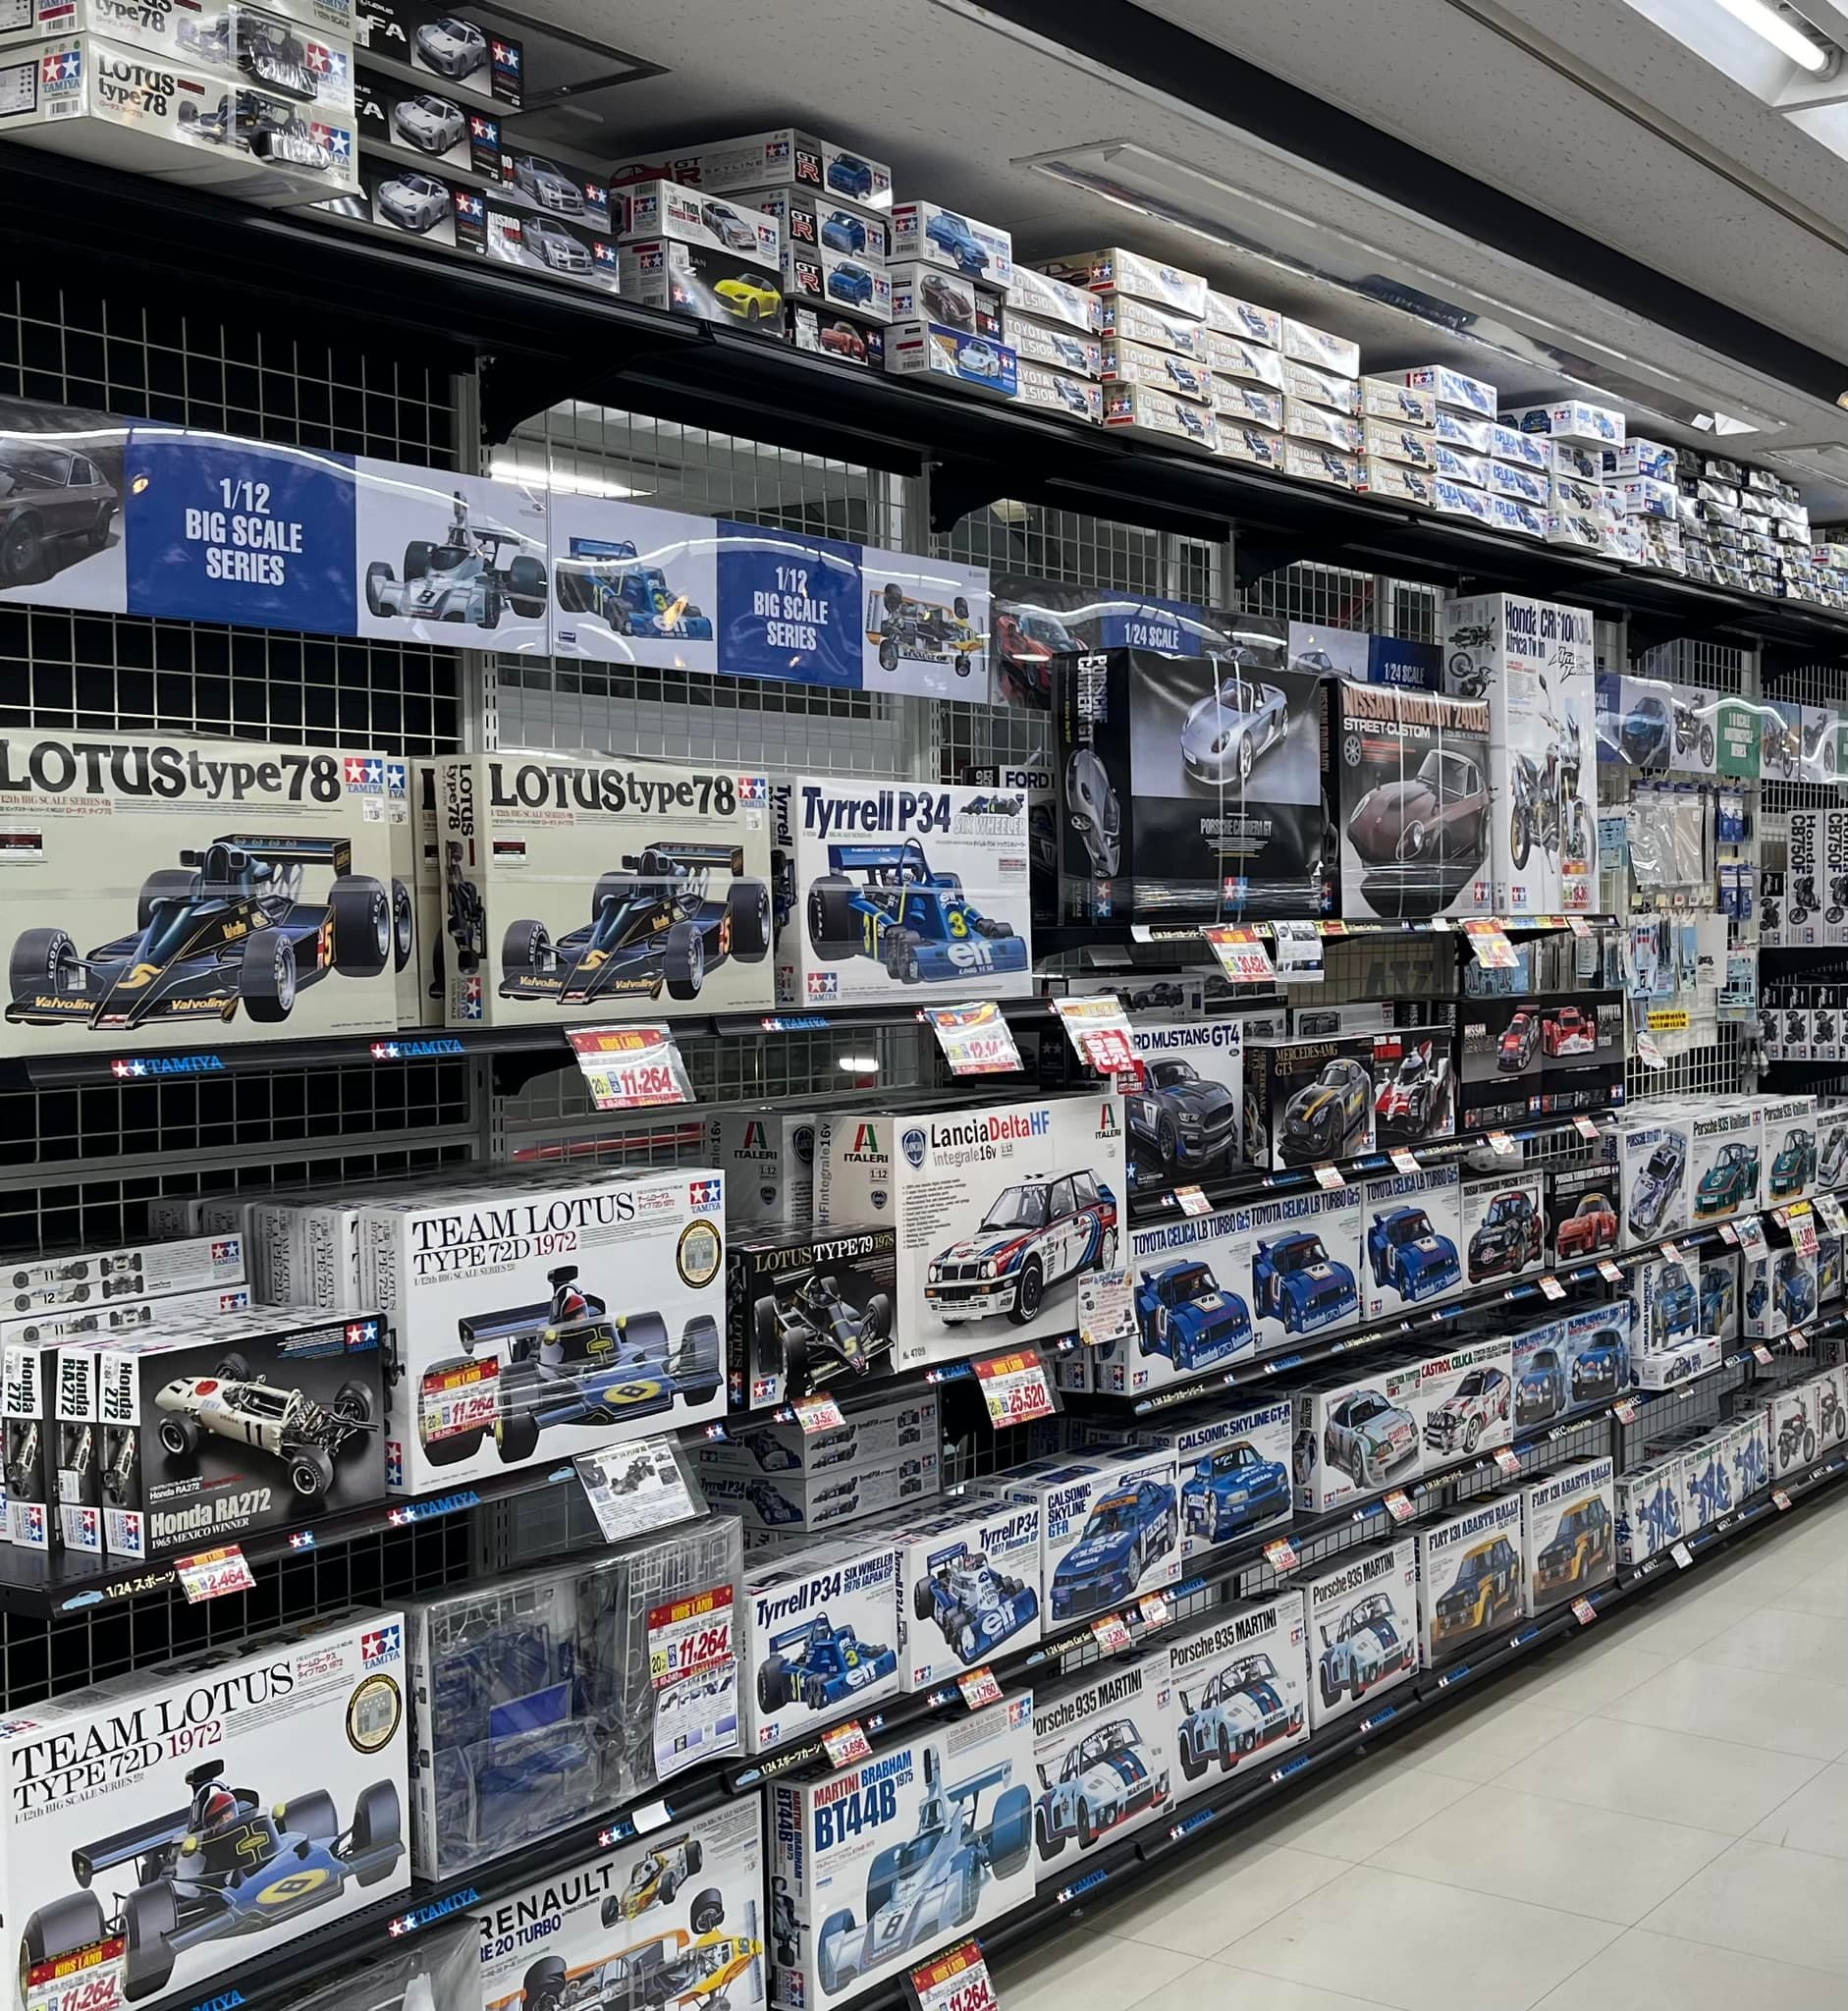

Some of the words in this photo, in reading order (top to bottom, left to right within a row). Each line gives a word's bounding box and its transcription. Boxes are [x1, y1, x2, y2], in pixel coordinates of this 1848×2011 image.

[99, 54, 176, 96] LOTUS
[99, 77, 168, 117] type78
[704, 158, 764, 175] SKYLINE
[219, 476, 271, 516] 1/12
[186, 509, 226, 542] BIG
[232, 515, 303, 554] SCALE
[206, 547, 285, 586] SERIES
[775, 566, 807, 593] 1/12
[753, 593, 782, 618] BIG
[784, 596, 828, 626] SCALE
[1504, 600, 1538, 634] Honda
[767, 621, 817, 652] SERIES
[1123, 622, 1148, 646] 1/24
[1149, 625, 1179, 651] SCALE
[1093, 654, 1109, 724] PORSCHE
[1384, 662, 1401, 681] 1/24
[1402, 665, 1425, 685] SCALE
[1343, 686, 1395, 720] NISSAN
[347, 784, 385, 795] TAMIYA
[1005, 769, 1049, 788] FORD
[445, 763, 461, 831] type78
[459, 763, 476, 837] LOTUS
[802, 787, 893, 840] Tyrrell
[898, 790, 951, 834] P34
[775, 785, 793, 847] Tyrrell
[974, 816, 1026, 836] WHEELER
[1790, 814, 1805, 876] CB750F
[1805, 814, 1817, 875] Honda
[1827, 812, 1842, 873] CB750F
[950, 910, 968, 938] 3
[947, 941, 994, 967] elf
[35, 996, 96, 1011] Valvoline
[171, 997, 232, 1011] Valvoline
[808, 993, 838, 1002] TAMIYA
[400, 1039, 465, 1059] TAMIYA
[1153, 1027, 1211, 1049] MUSTANG
[1212, 1024, 1239, 1047] GT4
[146, 1055, 225, 1074] TAMIYA
[591, 1077, 605, 1095] 20
[621, 1066, 673, 1094] 11,264
[1276, 1062, 1293, 1077] GT3
[1095, 1127, 1121, 1140] ITALERI
[734, 1149, 778, 1161] ITALERI
[843, 1153, 889, 1165] ITALERI
[412, 1208, 520, 1252] TEAM
[524, 1191, 635, 1234] LOTUS
[690, 1202, 722, 1215] TAMIYA
[1251, 1204, 1282, 1227] TOYOTA
[1281, 1197, 1310, 1220] CELICA
[1310, 1196, 1321, 1214] LB
[1320, 1190, 1347, 1212] TURBO
[1132, 1232, 1168, 1256] TOYOTA
[1167, 1225, 1197, 1248] CELICA
[1197, 1223, 1209, 1239] LB
[1208, 1214, 1236, 1238] TURBO
[211, 1255, 241, 1266] TAMIYA
[413, 1245, 486, 1276] TYPE
[488, 1237, 531, 1269] 72D
[533, 1229, 577, 1257] 1972
[754, 1247, 813, 1275] LOTUS
[42, 1292, 56, 1306] 12
[1421, 1358, 1451, 1379] CASTROL
[1451, 1351, 1474, 1371] CELICA
[21, 1355, 35, 1415] Honda
[61, 1357, 77, 1416] RA272
[76, 1359, 89, 1418] Honda
[119, 1361, 134, 1421] Honda
[1008, 1382, 1047, 1417] 25,520
[452, 1394, 496, 1425] 11,264
[1178, 1423, 1228, 1451] CALSONIC
[1229, 1410, 1270, 1437] SKYLINE
[1270, 1403, 1291, 1425] GT-R
[149, 1487, 176, 1500] Honda
[175, 1480, 201, 1495] RA272
[1048, 1484, 1092, 1508] CALSONIC
[1532, 1488, 1549, 1509] FIAT
[1560, 1470, 1592, 1496] ABARTH
[1591, 1460, 1613, 1484] RALLY
[150, 1502, 213, 1539] Honda
[215, 1487, 272, 1525] RA272
[415, 1491, 482, 1515] TAMIYA
[1048, 1498, 1087, 1524] SKYLINE
[151, 1534, 172, 1549] 1965
[172, 1526, 212, 1547] MEXICO
[211, 1517, 250, 1540] WINNER
[979, 1523, 1014, 1552] Tyrrell
[1014, 1511, 1039, 1539] P34
[1048, 1521, 1069, 1538] GT-R
[1429, 1530, 1447, 1551] FIAT
[1447, 1523, 1460, 1542] 131
[1461, 1509, 1495, 1538] ABARTH
[1495, 1497, 1520, 1523] RALLY
[208, 1568, 245, 1592] 2,464
[842, 1566, 859, 1582] SIX
[859, 1551, 895, 1579] WHEELER
[1312, 1577, 1348, 1606] Porsche
[1347, 1569, 1363, 1591] 935
[1363, 1551, 1395, 1582] MARTINI
[106, 1581, 132, 1599] 1/24
[134, 1570, 177, 1594] スポーツ
[756, 1582, 808, 1630] Tyrrell
[809, 1568, 842, 1603] P34
[691, 1596, 714, 1616] LAND
[982, 1602, 1015, 1637] elf
[650, 1656, 662, 1674] 20
[679, 1625, 730, 1667] 11,264
[1170, 1634, 1216, 1668] Porsche
[1215, 1623, 1235, 1651] 935
[1235, 1607, 1277, 1642] MARTINI
[297, 1653, 337, 1671] チームロータス
[361, 1651, 402, 1670] TAMIYA
[844, 1659, 877, 1687] elf
[1075, 1690, 1098, 1718] 935
[1098, 1668, 1143, 1709] MARTINI
[11, 1707, 153, 1784] TEAM
[155, 1660, 295, 1735] LOTUS
[13, 1762, 109, 1812] TYPE
[109, 1740, 165, 1782] 72D
[166, 1719, 223, 1761] 1972
[813, 1772, 860, 1809] MARTINI
[860, 1749, 913, 1786] BRABHAM
[45, 1801, 64, 1814] BIG
[65, 1788, 98, 1808] SCALE
[98, 1777, 134, 1797] SERIES
[814, 1778, 897, 1854] BT44B
[896, 1770, 915, 1789] 1975
[776, 1786, 793, 1844] BT44B
[793, 1830, 804, 1880] BRABHAM
[416, 1887, 481, 1923] TAMIYA
[480, 1863, 615, 1939] RENAULT
[495, 1933, 515, 1956] 20
[516, 1914, 563, 1949] TURBO
[54, 1958, 77, 1978] KIDS
[78, 1949, 103, 1972] LAND
[61, 1975, 116, 2011] 11,264
[950, 1980, 990, 2011] 11,264
